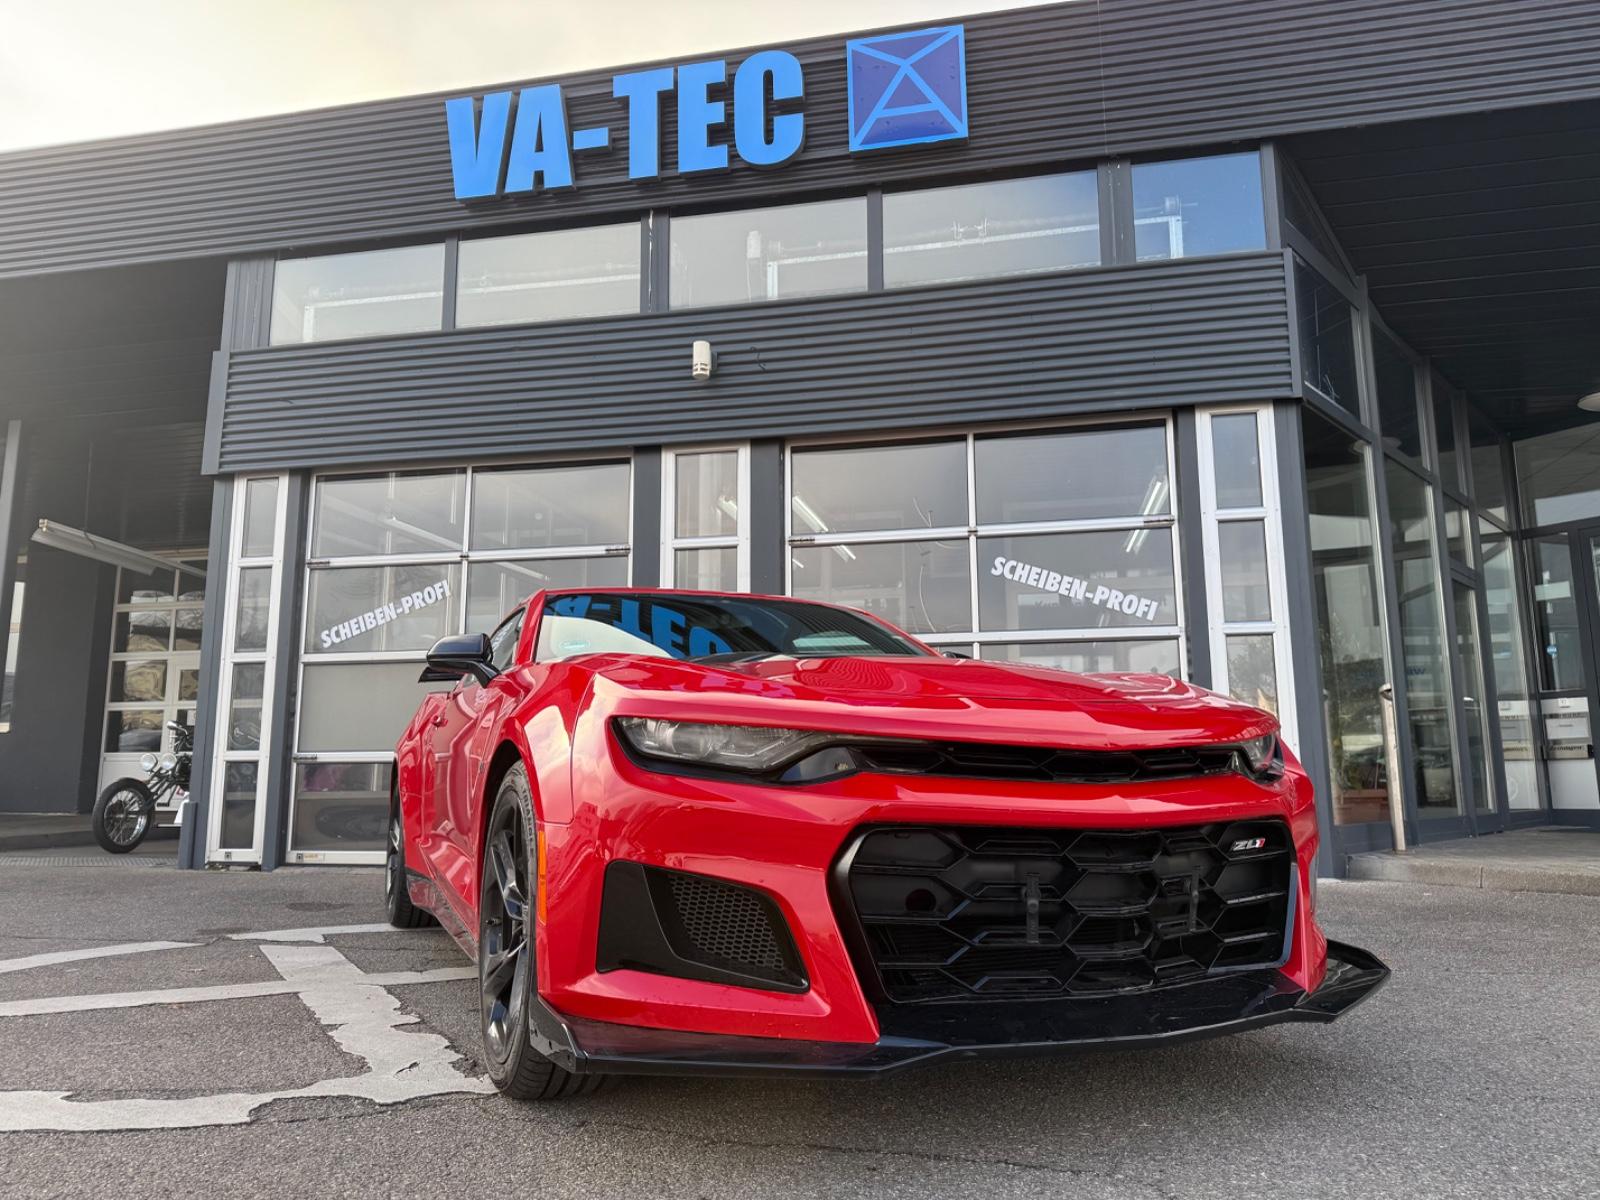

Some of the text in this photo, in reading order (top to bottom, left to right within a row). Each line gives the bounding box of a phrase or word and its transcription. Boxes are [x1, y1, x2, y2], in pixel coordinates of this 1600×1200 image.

[445, 50, 804, 199] VA-TEC
[320, 579, 451, 649] SCHEIBEN-PROFI
[990, 556, 1158, 621] SCHEIBEN-PROFI
